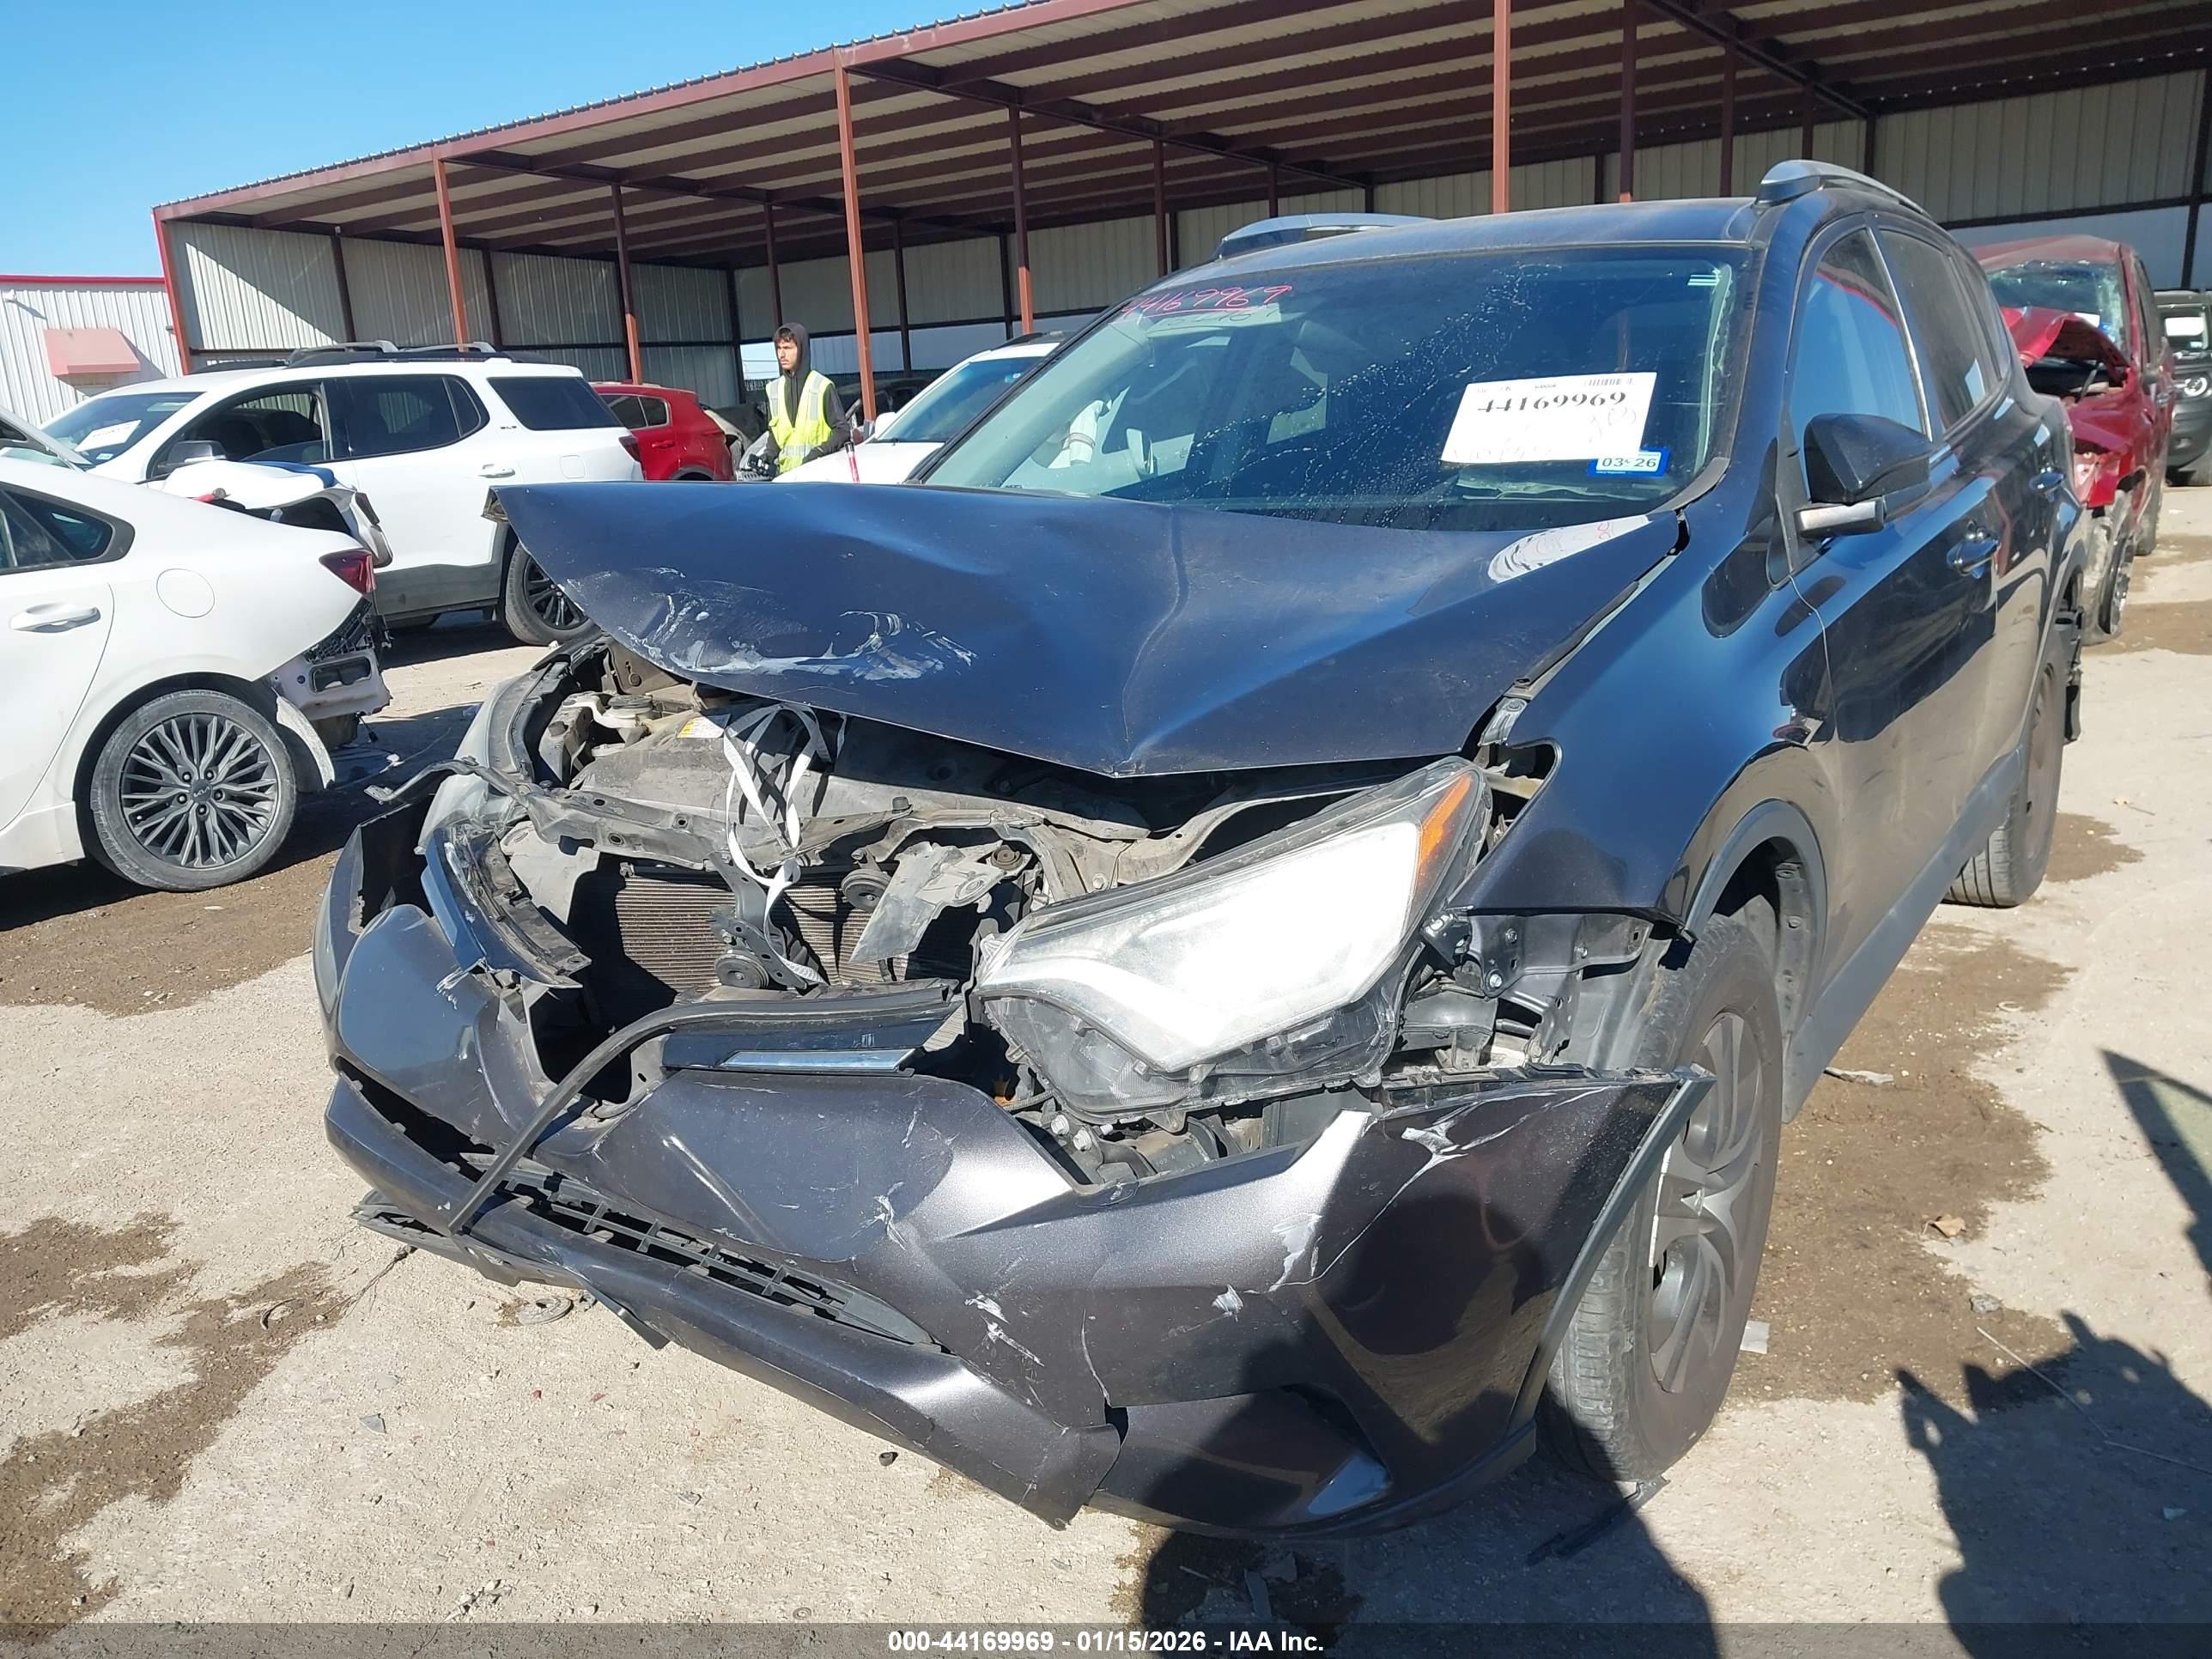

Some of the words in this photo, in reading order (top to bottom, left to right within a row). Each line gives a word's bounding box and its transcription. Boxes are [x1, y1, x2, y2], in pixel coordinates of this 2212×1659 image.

[1477, 392, 1626, 413] 44169969
[1601, 457, 1625, 468] 03
[1633, 458, 1657, 468] 26
